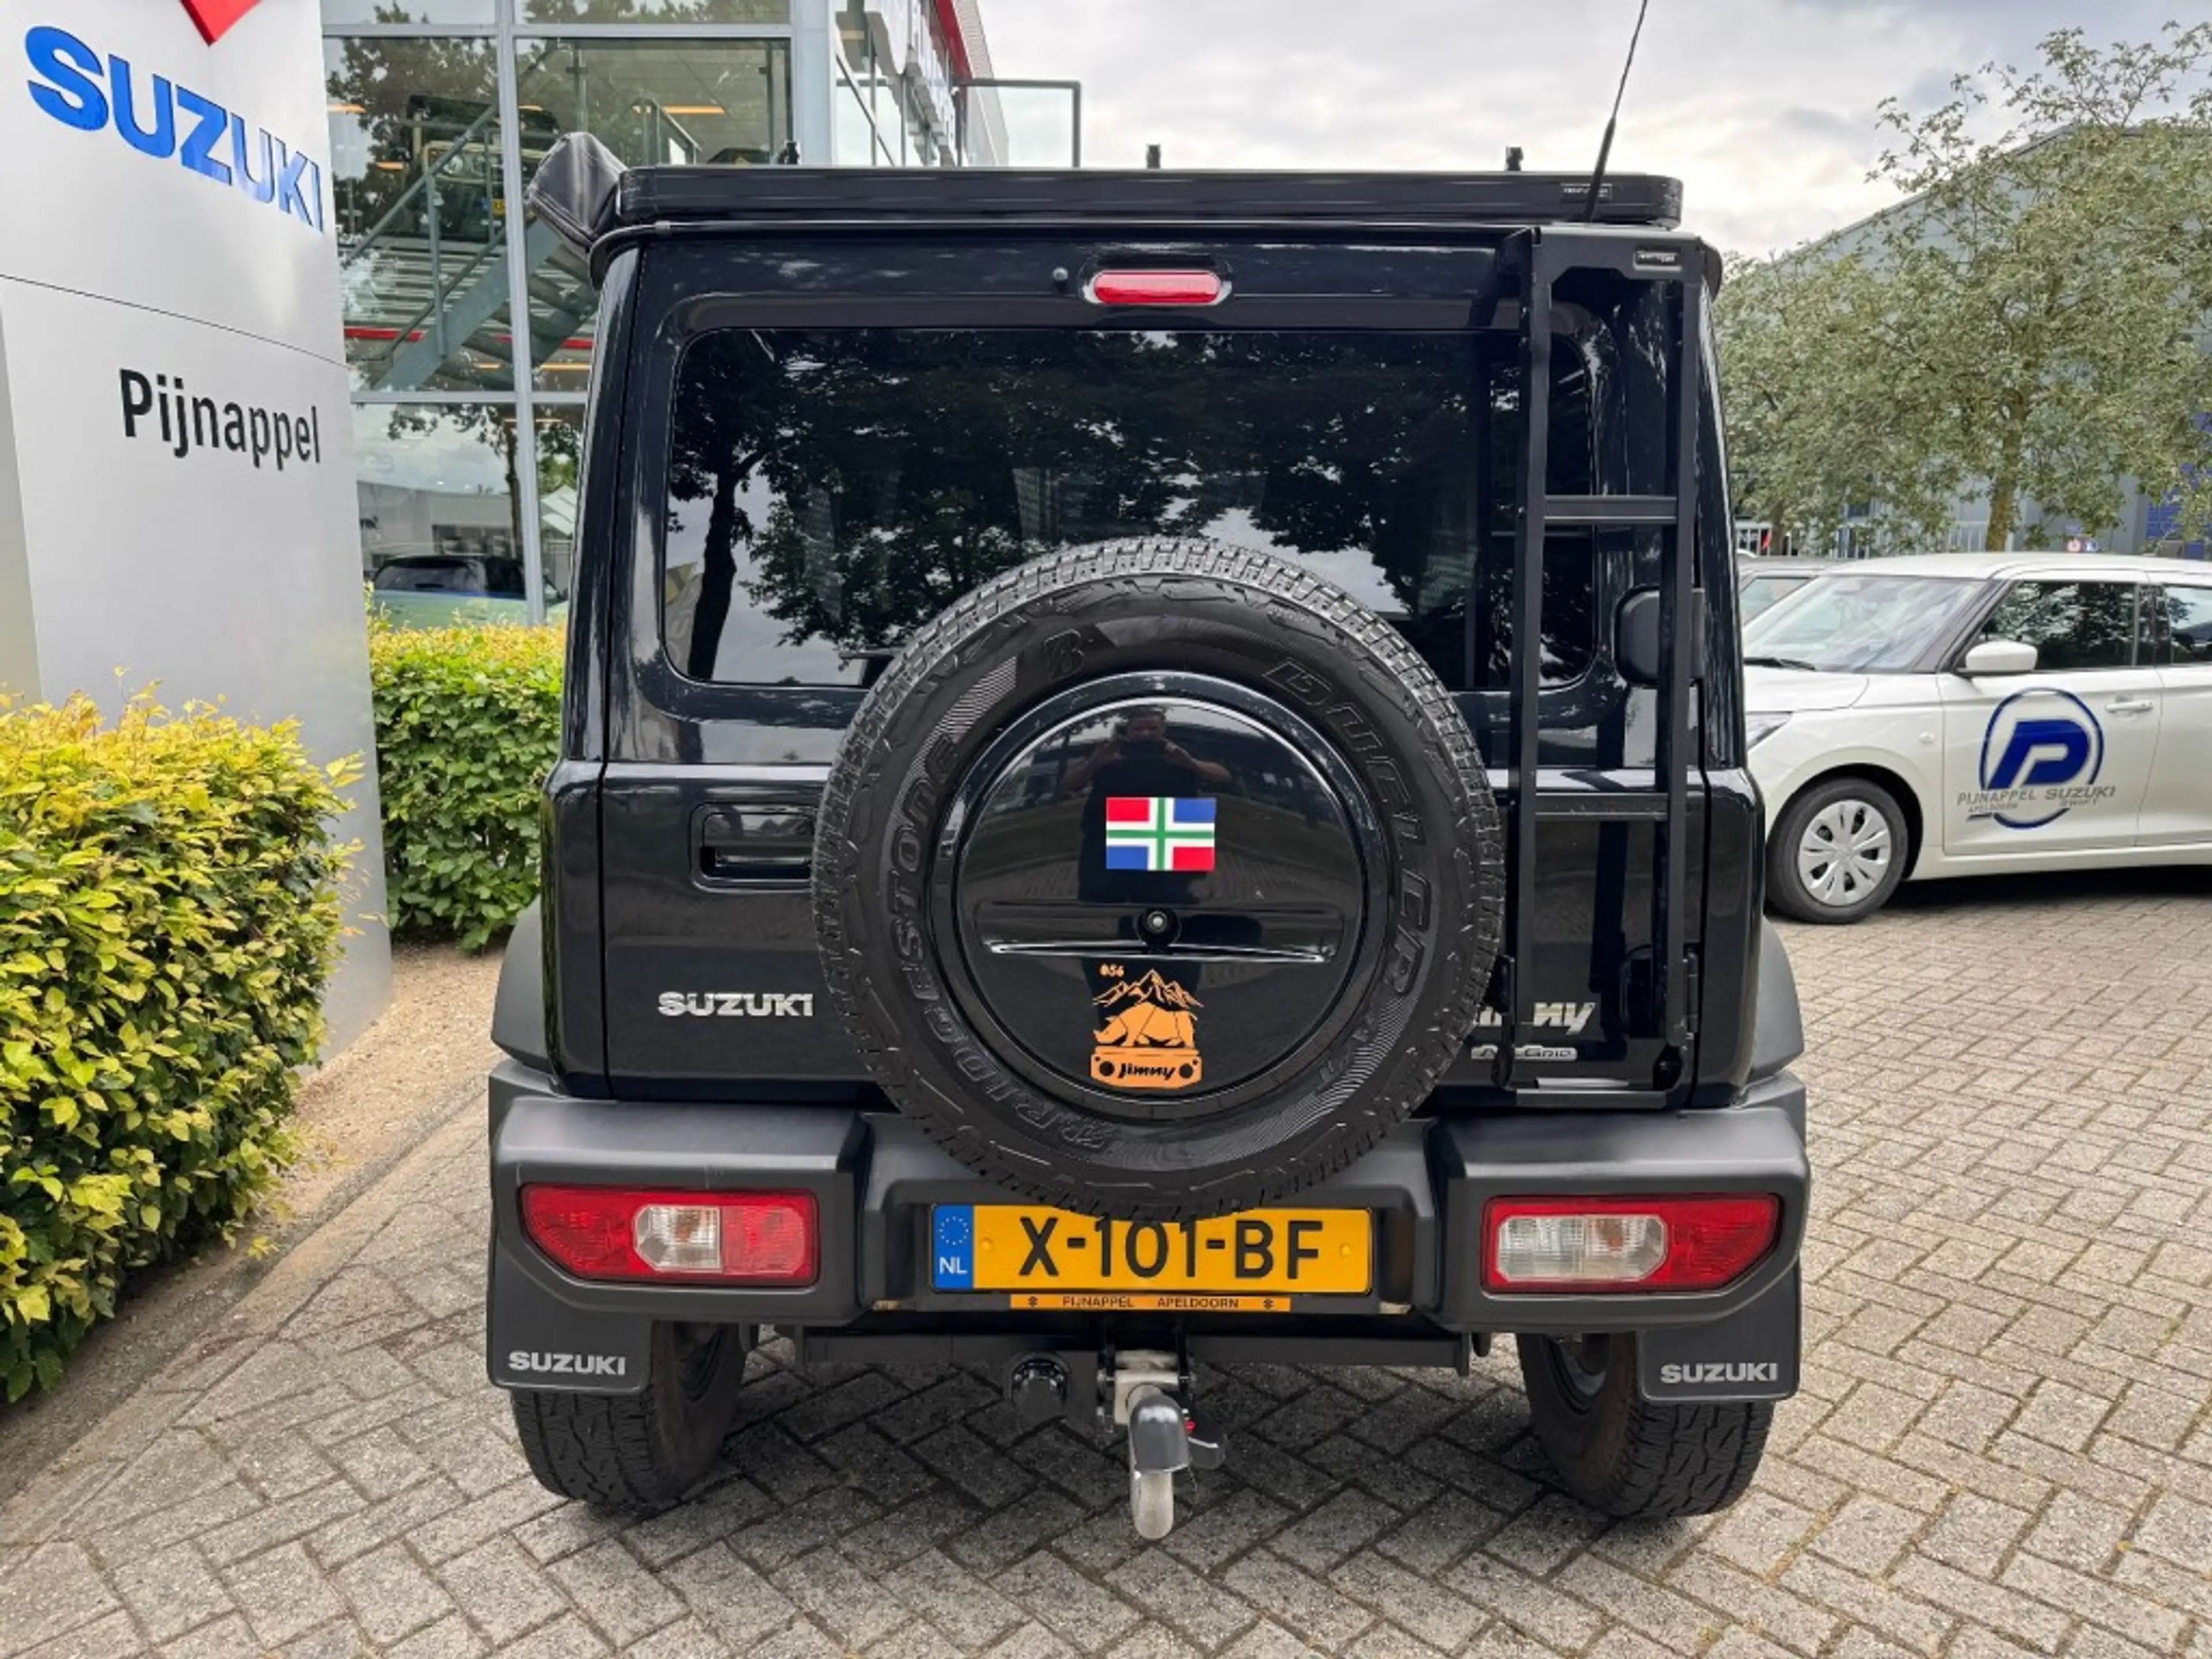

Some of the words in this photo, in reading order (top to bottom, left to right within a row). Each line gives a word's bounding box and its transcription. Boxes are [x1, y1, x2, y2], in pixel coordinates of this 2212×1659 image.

[25, 26, 324, 234] SUZUKI
[119, 369, 321, 471] Pijnappel
[2043, 785, 2116, 801] SUZUKI
[657, 991, 814, 1017] SUZUKI
[940, 1257, 968, 1275] NL
[1018, 1215, 1324, 1280] X-101-BF
[1062, 1296, 1135, 1309] PIJNAPPEL
[1157, 1297, 1240, 1309] APELDOORN
[508, 1350, 626, 1376] SUZUKI
[1660, 1362, 1779, 1384] SUZUKI
